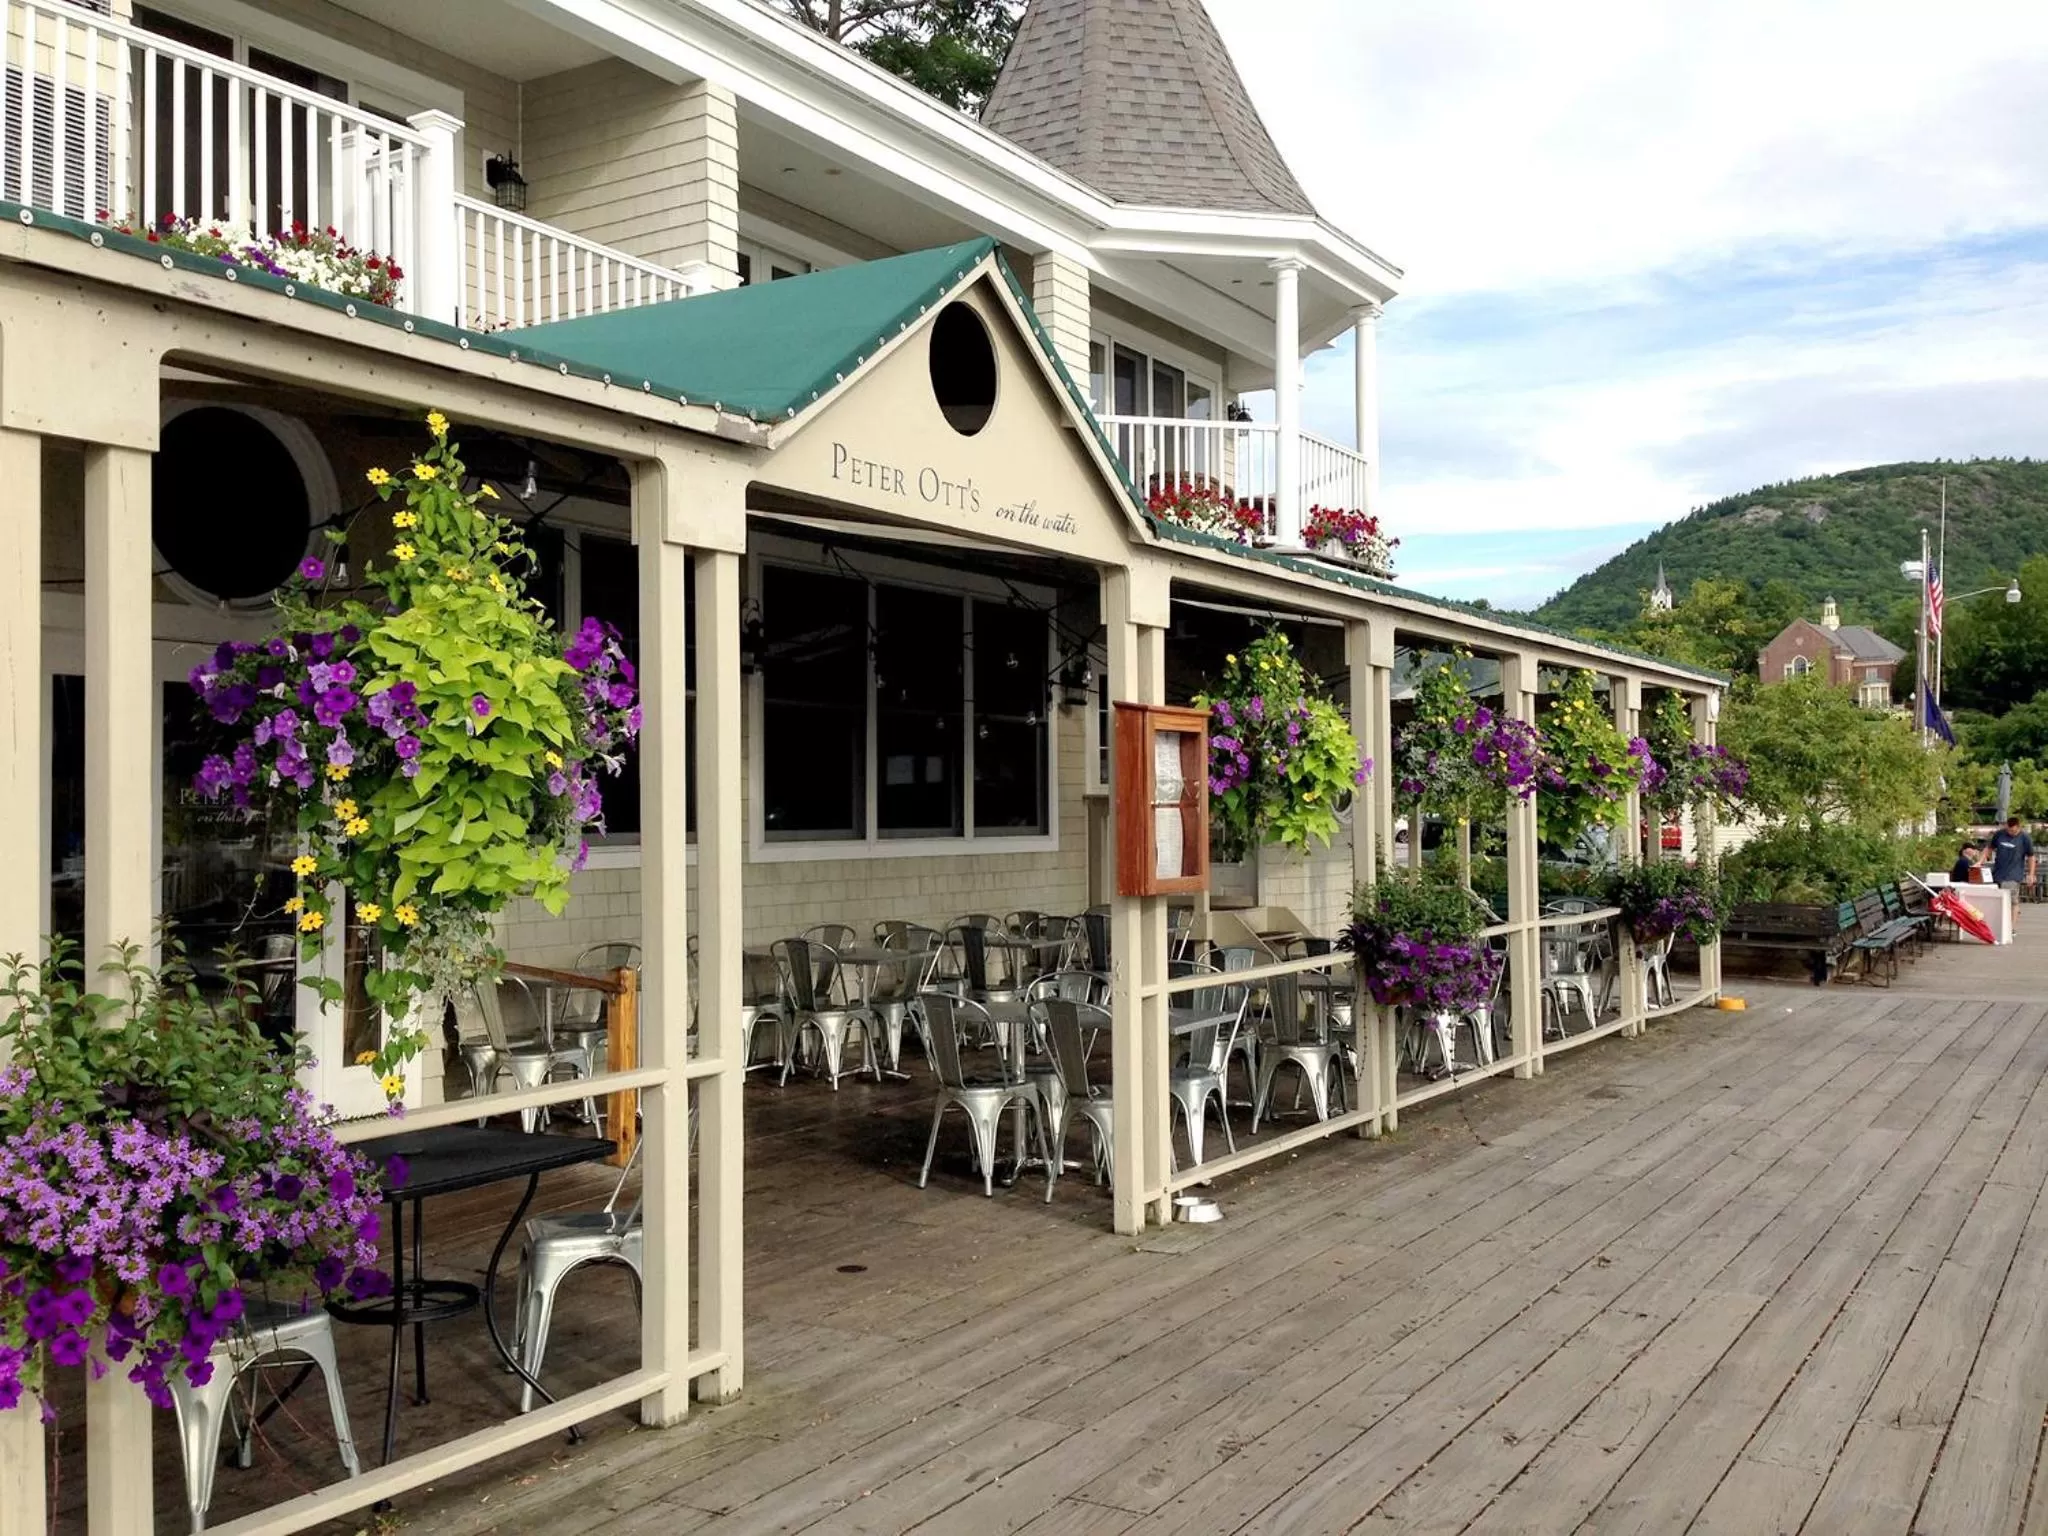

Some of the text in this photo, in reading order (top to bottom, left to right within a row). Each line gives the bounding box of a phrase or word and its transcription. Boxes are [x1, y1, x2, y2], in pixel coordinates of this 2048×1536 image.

[832, 442, 1078, 535] PETER OTT'S on the water
